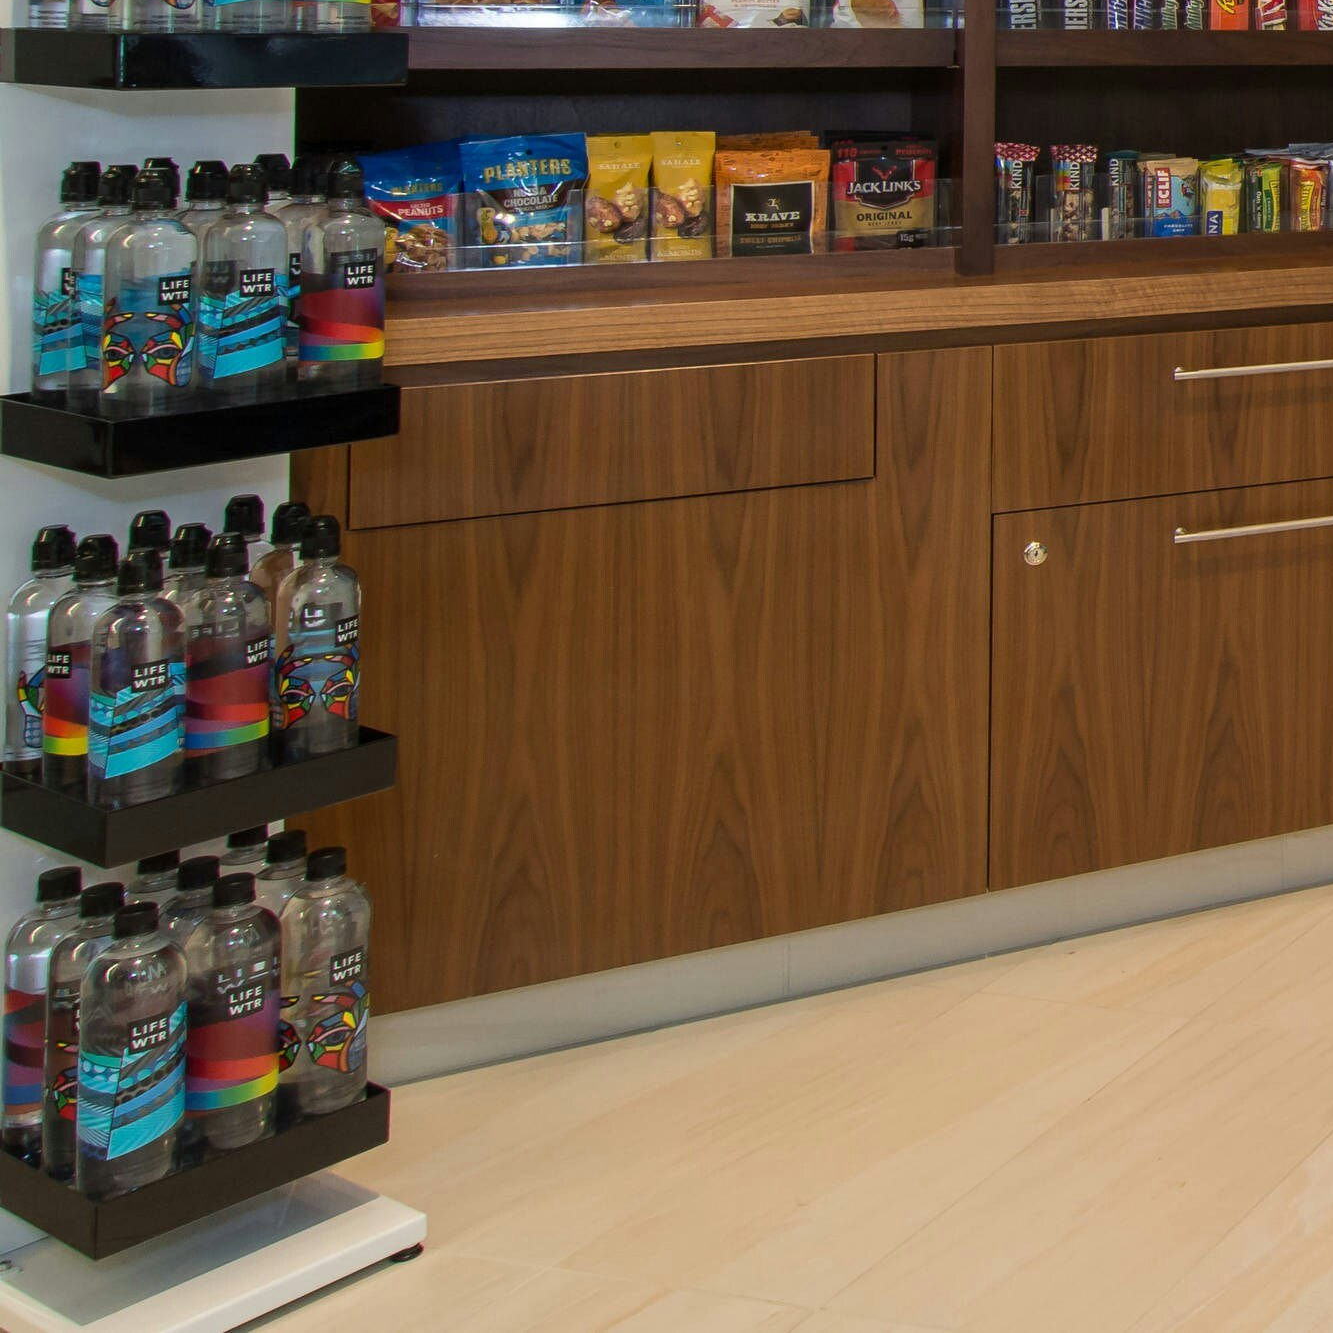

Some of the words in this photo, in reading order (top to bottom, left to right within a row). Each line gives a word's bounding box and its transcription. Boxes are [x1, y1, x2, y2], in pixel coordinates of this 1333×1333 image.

[483, 158, 571, 183] PLANTERS
[1011, 160, 1023, 189] KIND
[1069, 162, 1080, 190] KIND
[1109, 159, 1119, 186] KIND
[846, 182, 881, 195] JACK
[1158, 170, 1170, 199] CLIF
[503, 195, 560, 207] CHOCOLATE
[398, 204, 443, 217] PEANUTS
[744, 211, 800, 222] KRAVE
[856, 211, 913, 222] ORIGINAL
[347, 265, 374, 275] LIFE
[242, 272, 272, 283] LIFE
[347, 275, 374, 285] WTR
[162, 279, 190, 290] LIFE
[243, 283, 272, 293] WTR
[133, 664, 166, 677] LIFE
[133, 675, 166, 688] WTR
[333, 952, 363, 970] LIFE
[333, 964, 362, 981] WTR
[229, 985, 262, 1004] LIFE
[229, 998, 262, 1016] WTR
[132, 1017, 168, 1036] LIFE
[132, 1030, 167, 1049] WTR
